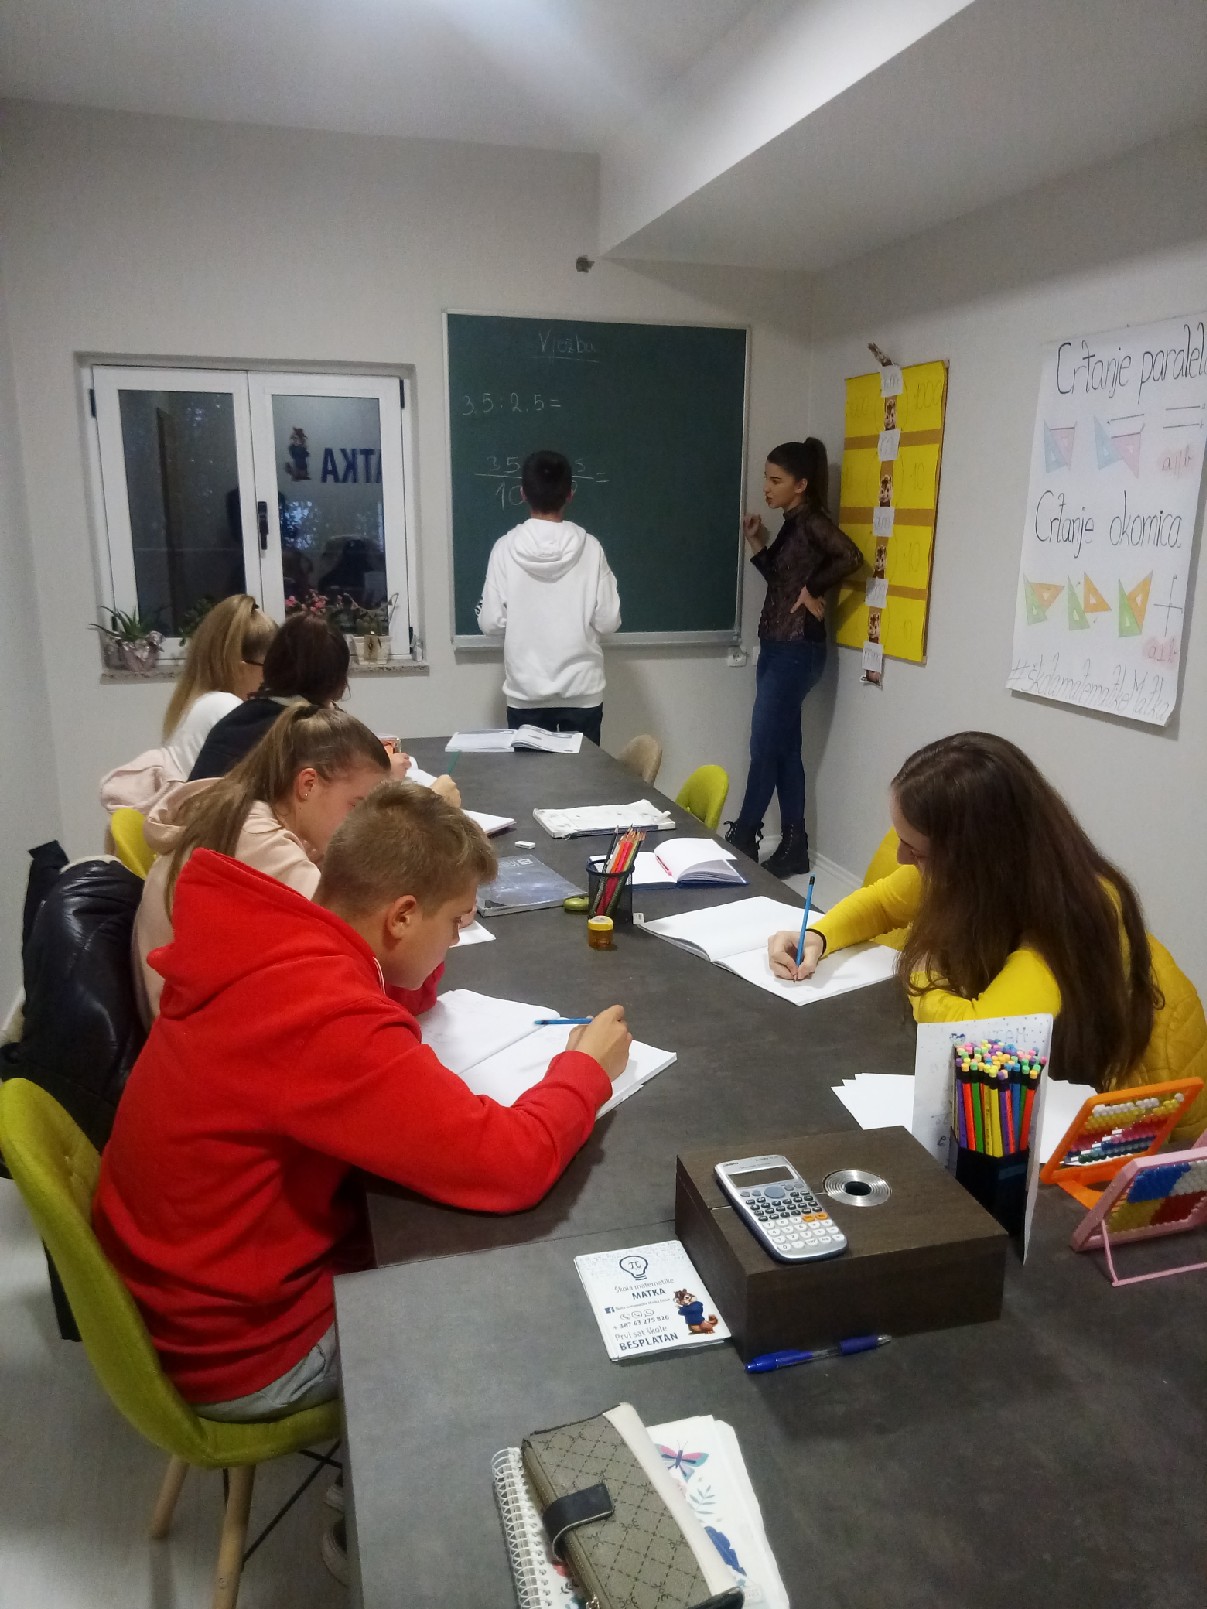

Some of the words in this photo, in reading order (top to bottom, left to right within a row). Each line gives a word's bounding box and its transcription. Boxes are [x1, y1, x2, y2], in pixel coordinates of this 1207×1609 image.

[1056, 339, 1132, 399] Crtanje
[1035, 489, 1095, 559] Crtanje
[1109, 489, 1183, 549] okomica
[631, 1287, 666, 1300] MATKA
[618, 1332, 679, 1351] BESPLATAN
